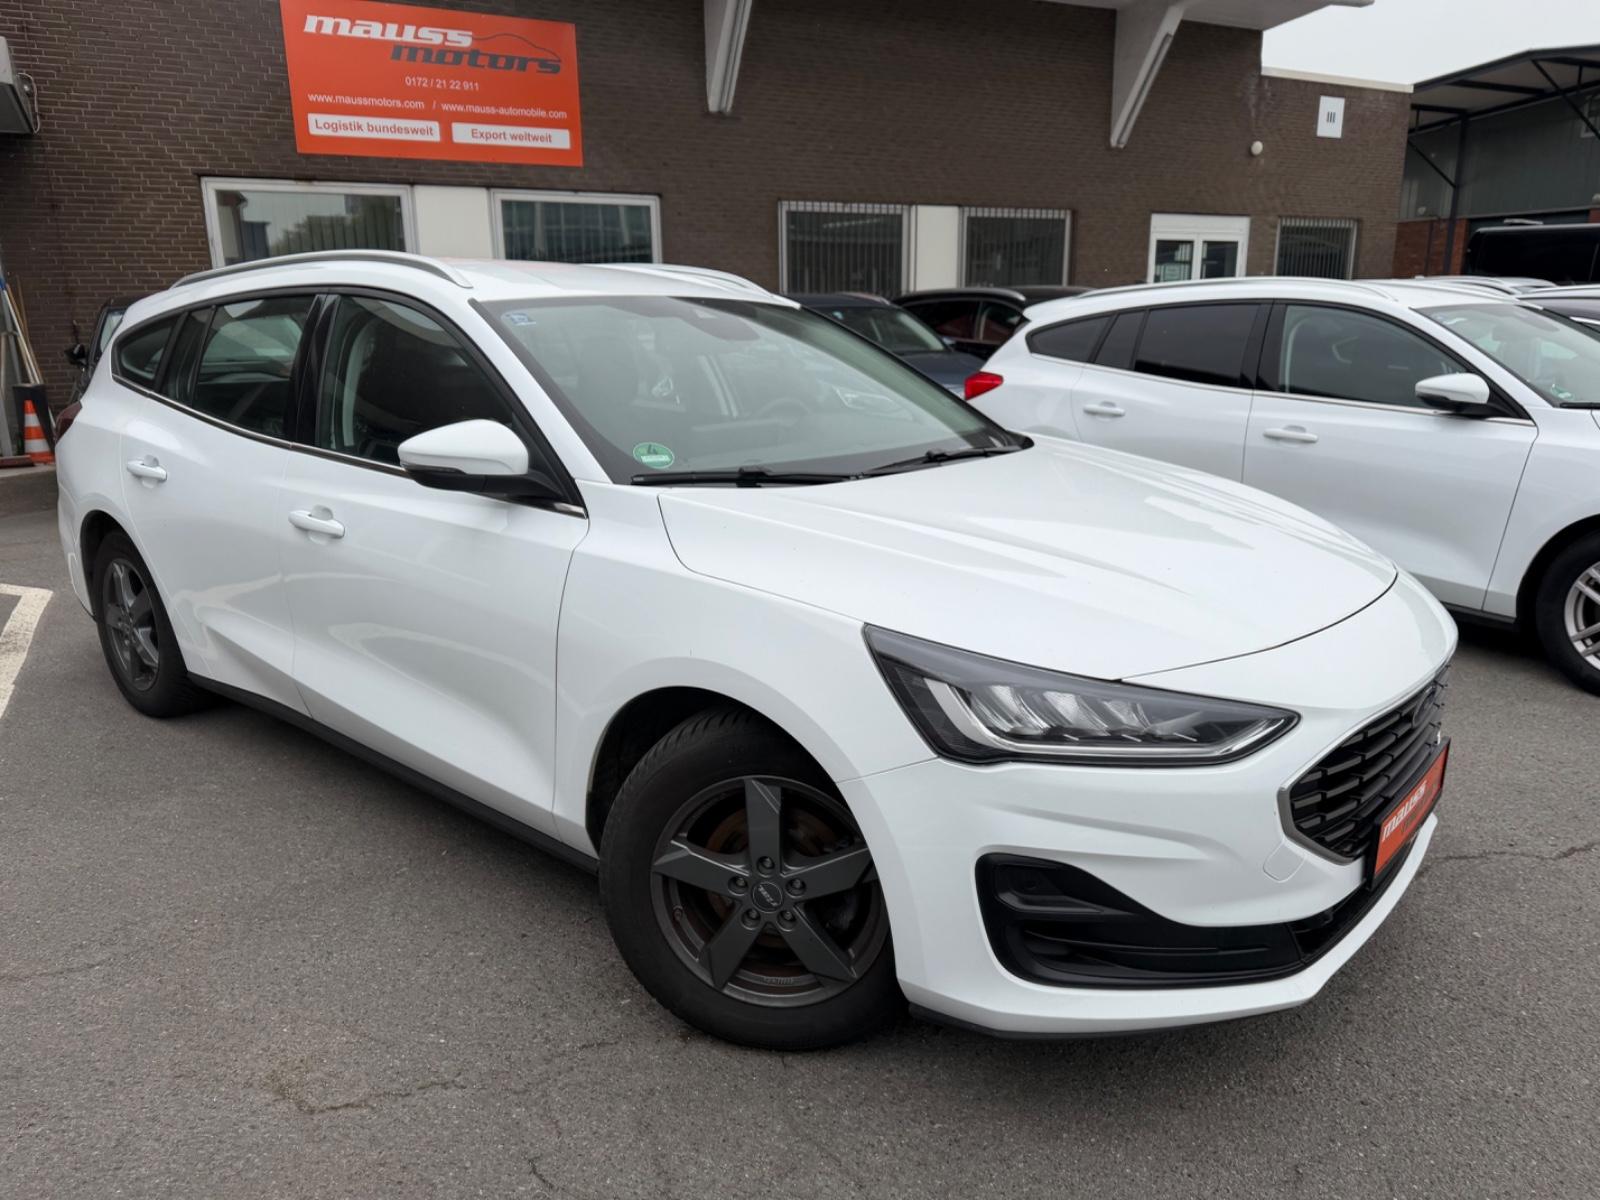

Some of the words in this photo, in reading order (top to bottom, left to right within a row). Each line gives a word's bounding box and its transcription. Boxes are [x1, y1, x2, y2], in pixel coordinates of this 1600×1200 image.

[303, 14, 473, 47] mauss
[390, 44, 562, 75] motors
[405, 76, 428, 88] 0172
[436, 79, 447, 89] 21
[450, 80, 461, 90] 22
[463, 81, 480, 91] 911
[307, 93, 425, 109] www.maussmotors.com
[441, 102, 568, 119] www.mauss-automobile.com
[314, 118, 363, 133] Logistik
[366, 122, 434, 137] bundesweit
[471, 128, 507, 142] Export
